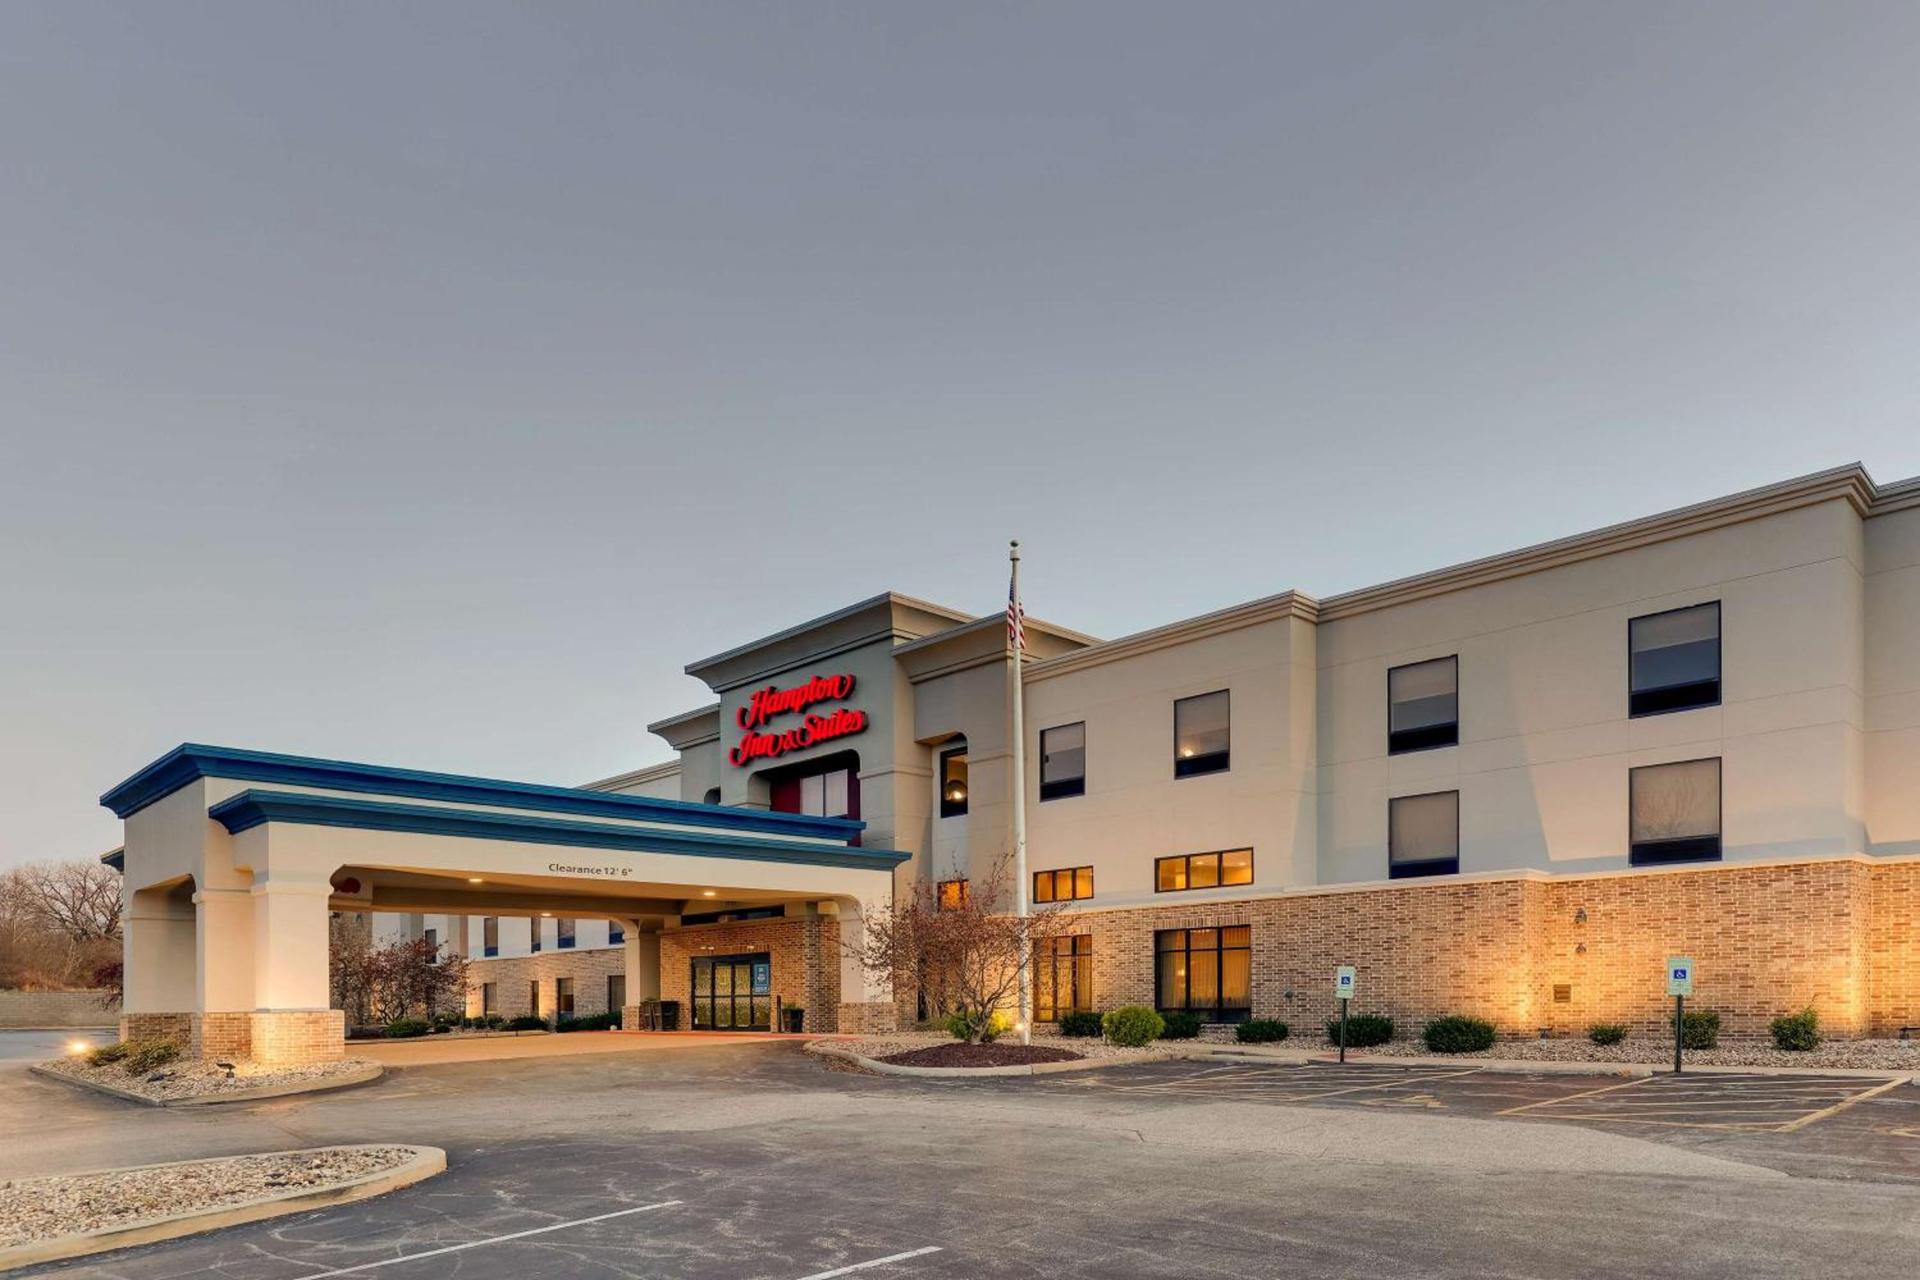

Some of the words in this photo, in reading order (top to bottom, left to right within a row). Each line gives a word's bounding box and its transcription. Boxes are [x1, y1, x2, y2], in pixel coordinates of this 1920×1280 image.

[736, 673, 856, 730] Hampton
[728, 731, 782, 768] Inn
[781, 729, 800, 751] &
[796, 707, 869, 748] Suites
[548, 863, 602, 875] Clearance
[604, 866, 619, 875] 12'
[621, 868, 633, 876] 6"
